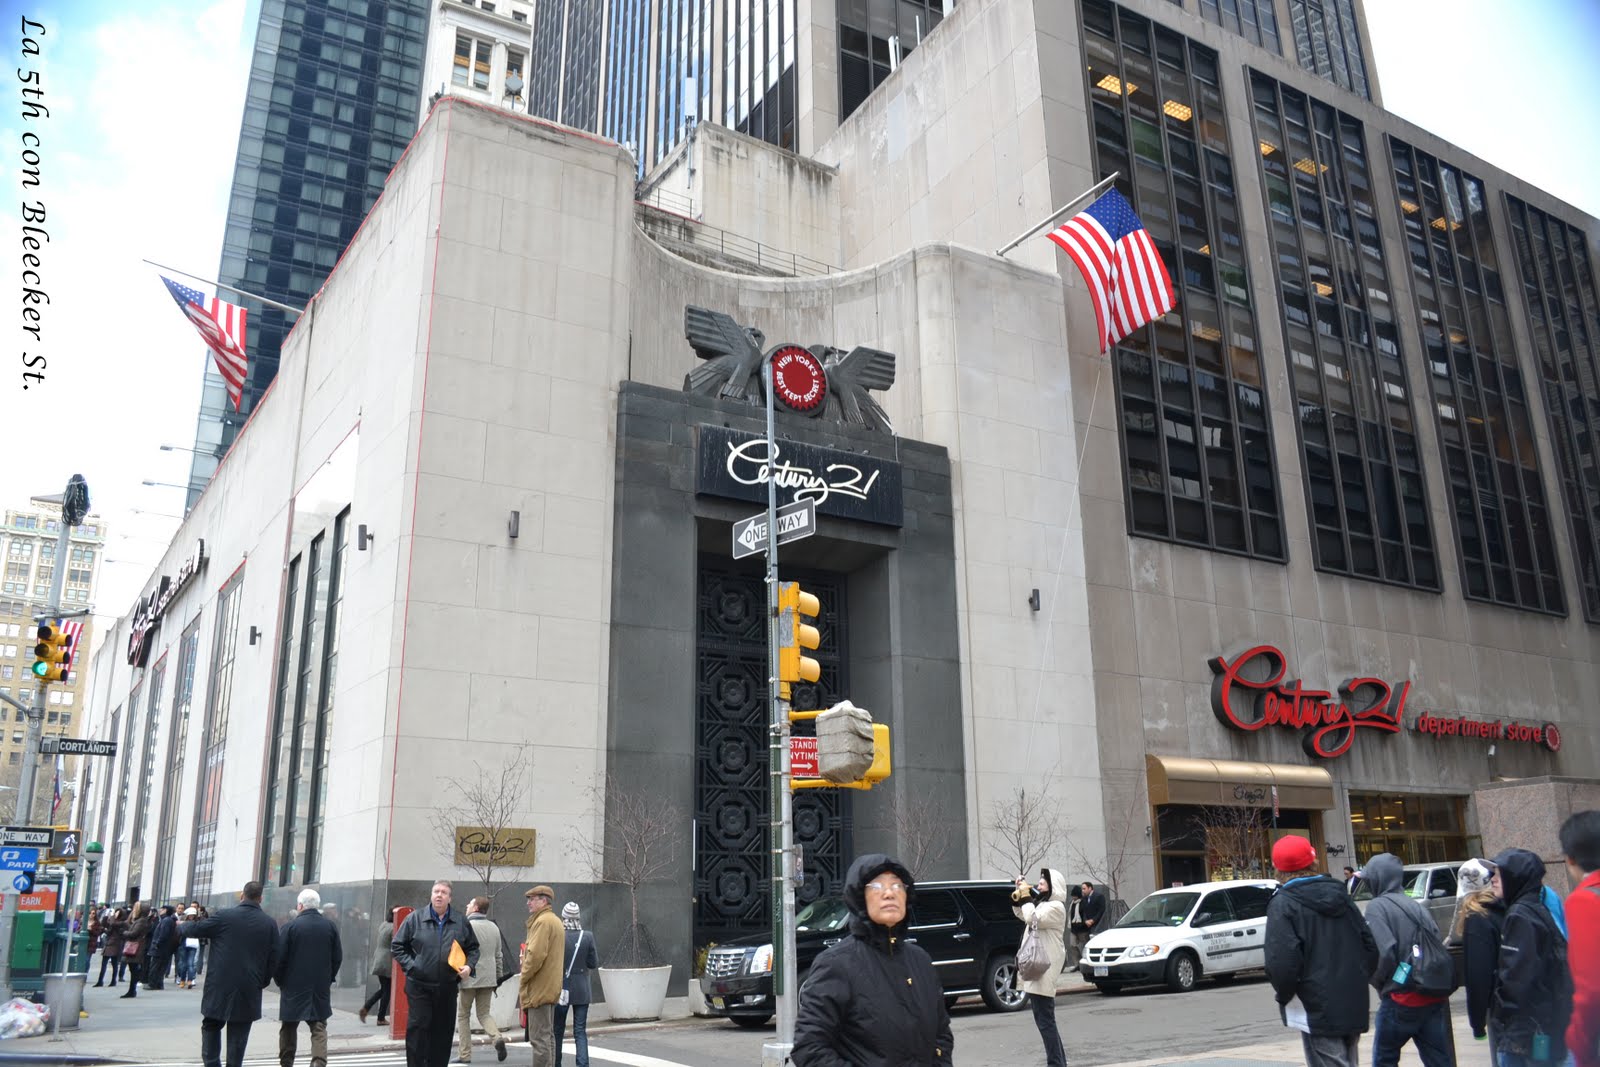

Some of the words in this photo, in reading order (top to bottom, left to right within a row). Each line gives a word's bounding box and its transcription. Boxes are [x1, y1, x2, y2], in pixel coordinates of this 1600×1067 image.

[777, 354, 793, 369] NEW
[794, 354, 818, 377] YORK'S
[776, 370, 787, 389] BEST
[783, 388, 802, 403] KEPT
[803, 378, 820, 403] SECRET
[727, 439, 829, 506] Century
[826, 464, 880, 500] 21
[745, 525, 767, 544] ONE
[777, 512, 803, 533] WAY
[1212, 645, 1356, 758] Century
[1347, 677, 1411, 732] 21
[1417, 710, 1503, 738] department
[1506, 720, 1542, 743] store
[59, 741, 111, 754] CORTLANDT
[25, 833, 45, 841] WAY
[506, 838, 533, 855] 21
[7, 861, 35, 869] PATH
